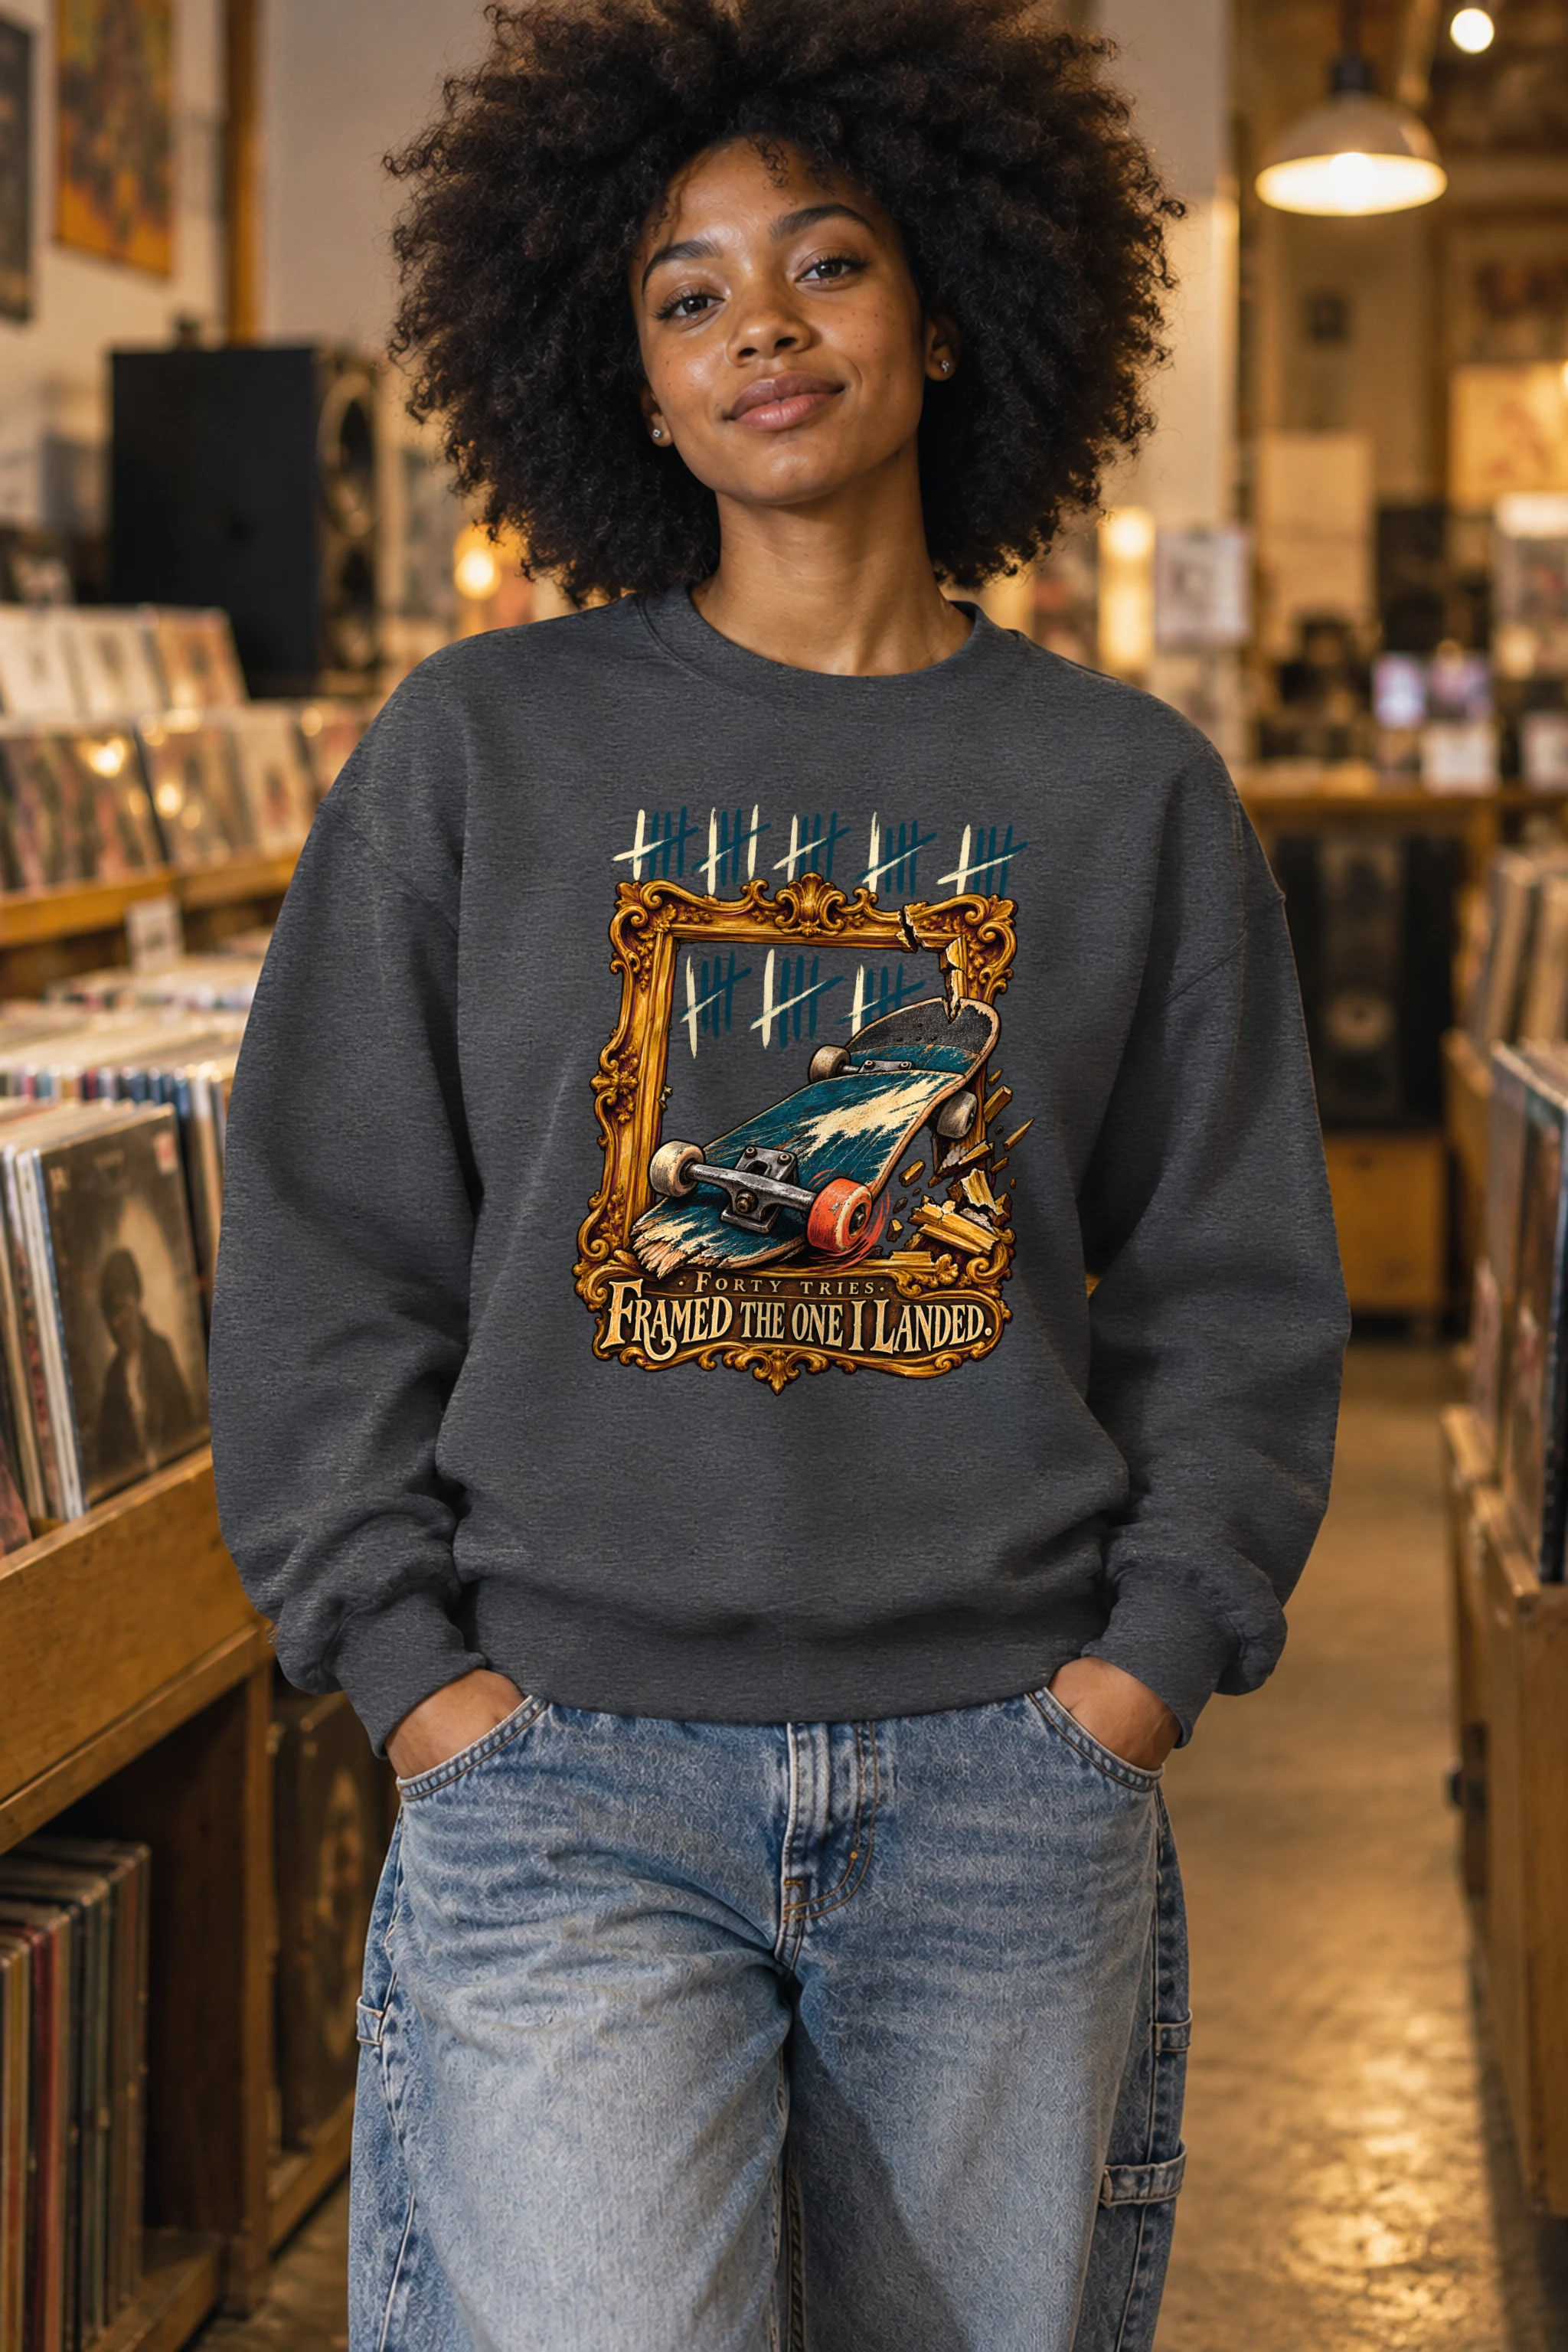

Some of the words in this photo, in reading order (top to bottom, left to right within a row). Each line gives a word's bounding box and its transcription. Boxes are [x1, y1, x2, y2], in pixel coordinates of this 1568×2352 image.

[694, 1271, 782, 1293] FORTY
[800, 1281, 874, 1295] TRIES
[600, 1278, 733, 1361] FRAMED
[740, 1301, 786, 1339] THE
[792, 1303, 844, 1348] ONE
[848, 1300, 866, 1351] I
[870, 1298, 992, 1354] LANDED.
